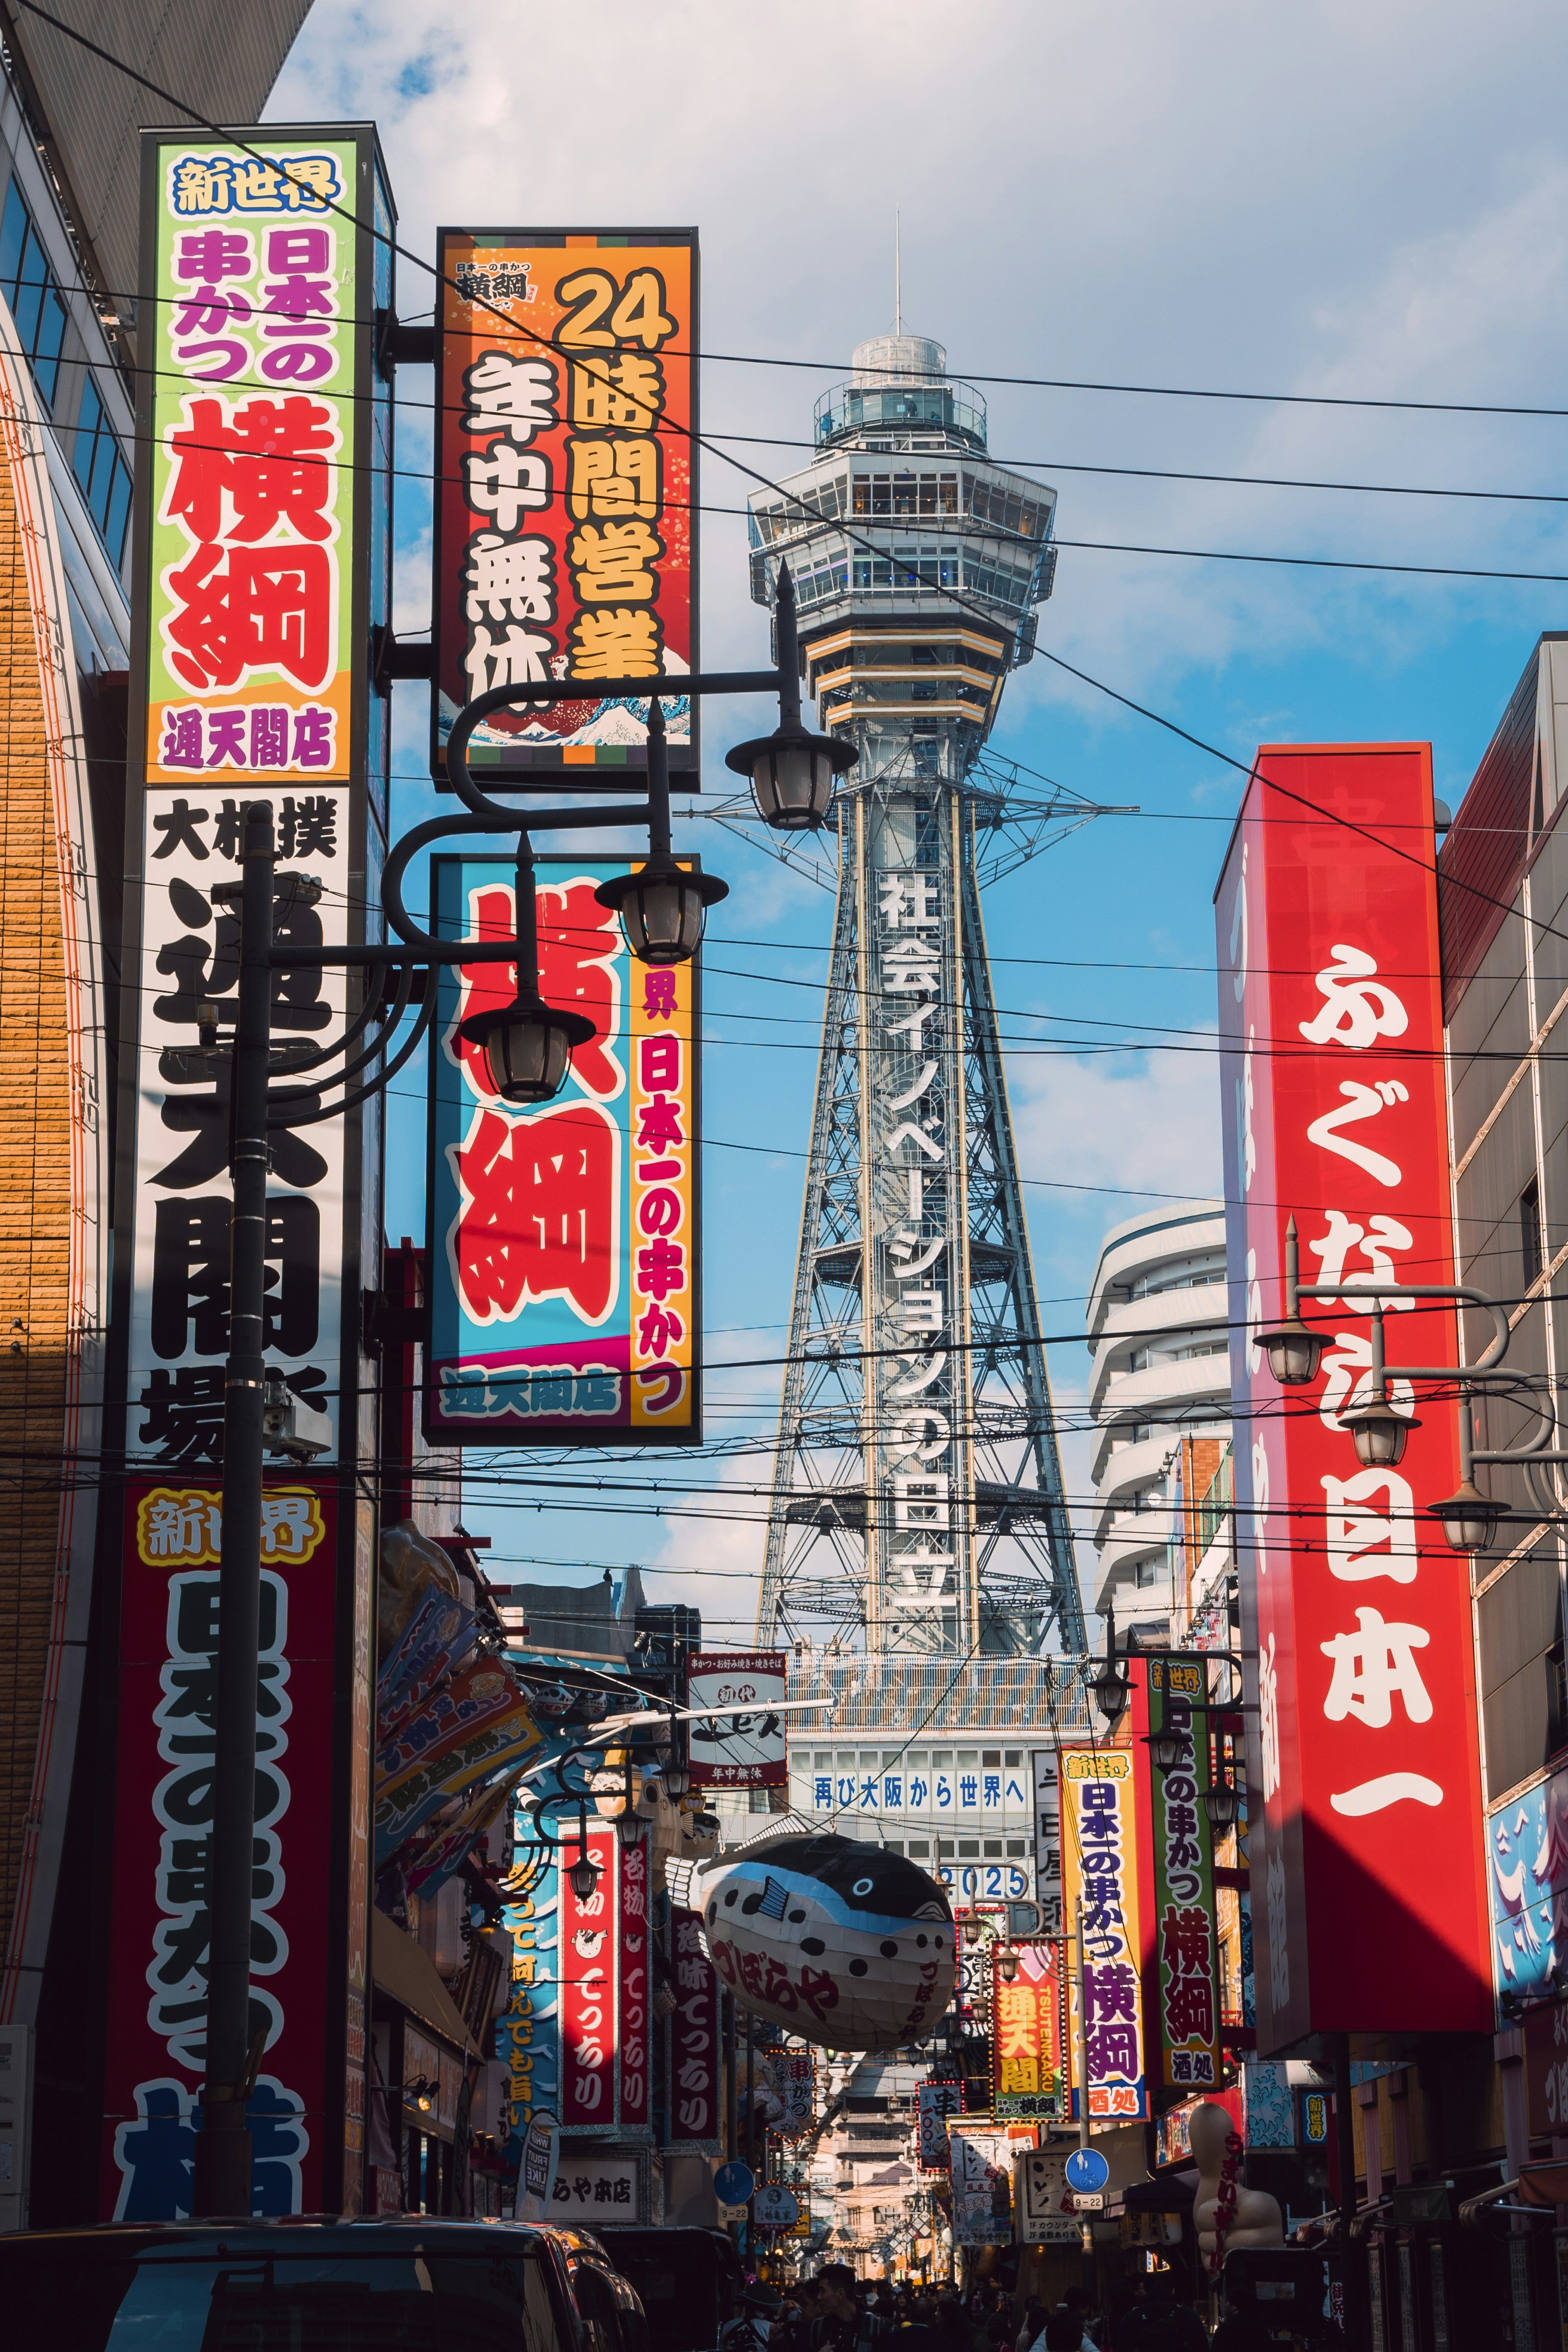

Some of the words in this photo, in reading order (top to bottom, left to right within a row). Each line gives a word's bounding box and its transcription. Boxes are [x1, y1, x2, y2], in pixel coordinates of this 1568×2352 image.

[176, 157, 338, 212] 新世界
[177, 230, 252, 381] 串かつ
[259, 229, 332, 381] 日本一の
[456, 263, 530, 271] 日本一の串かつ
[456, 272, 527, 301] 横綱
[167, 396, 332, 689] 横綱
[466, 356, 553, 712] 年中無休
[163, 707, 333, 769] 通天閣店
[636, 1034, 685, 1413] 日本一の串かつ
[878, 871, 957, 1609] 社会イノベーションの日立
[442, 1368, 620, 1415] 通天閣店
[719, 1686, 755, 1703] 初代
[711, 1767, 762, 1780] 年中無休
[814, 1775, 1024, 1808] 再び大阪から世界へ
[1067, 1755, 1128, 1778] 新世界
[1080, 1783, 1123, 1958] 日本一の串かつ
[677, 1919, 709, 2131] 珍味てっちり
[1075, 1964, 1136, 2081] 横綱
[1162, 1907, 1213, 2045] 横綱
[574, 1968, 604, 2109] てっちり
[623, 1968, 644, 2109] てっちり
[999, 1985, 1039, 2094] 通天閣
[1039, 1984, 1055, 2092] TSUTENKAKU
[1173, 2053, 1213, 2082] 酒処
[1019, 2096, 1056, 2114] 横綱
[1088, 2088, 1137, 2114] 酒処
[1309, 2096, 1324, 2139] 新世界
